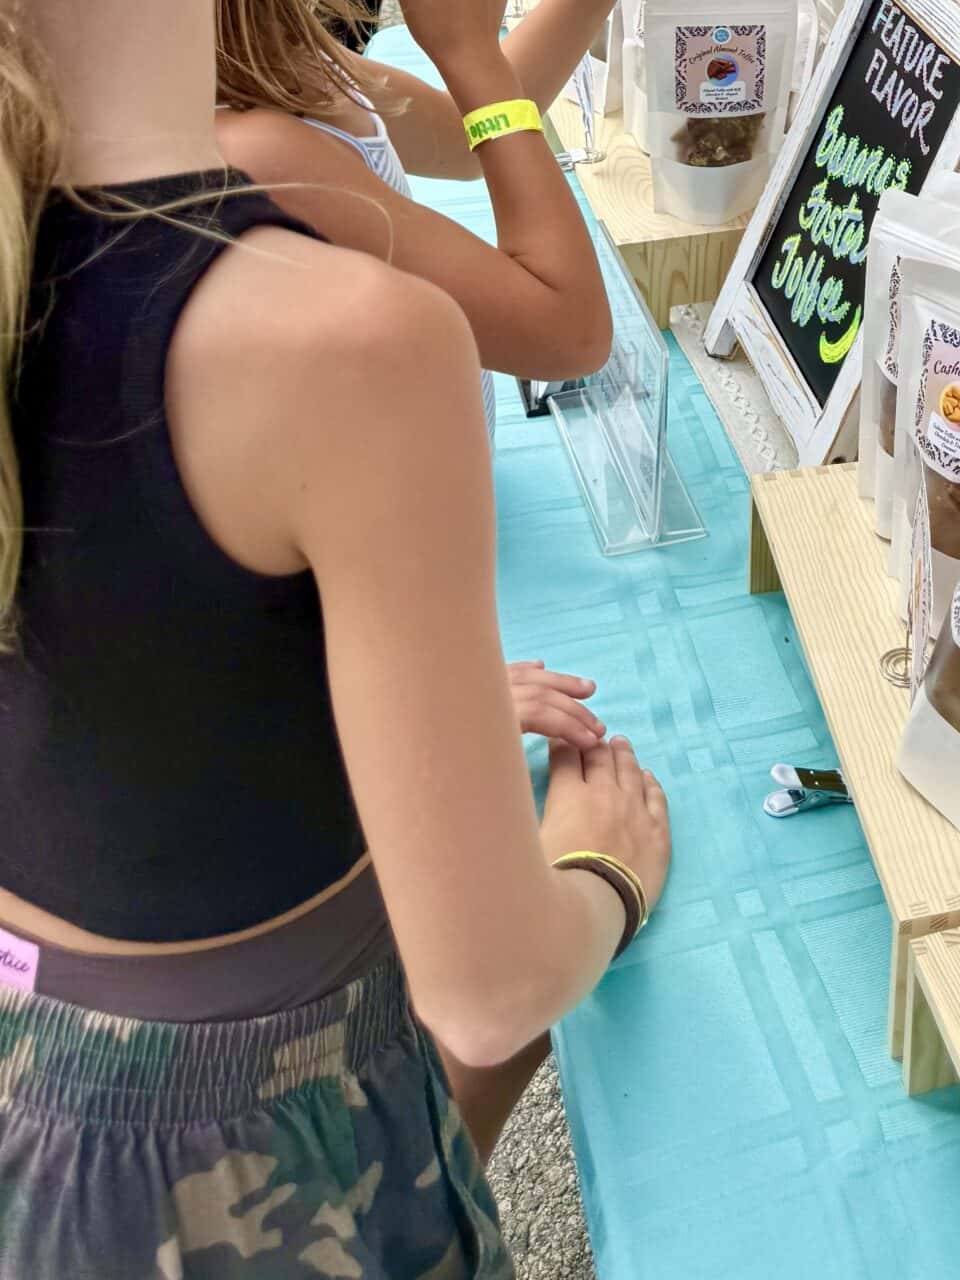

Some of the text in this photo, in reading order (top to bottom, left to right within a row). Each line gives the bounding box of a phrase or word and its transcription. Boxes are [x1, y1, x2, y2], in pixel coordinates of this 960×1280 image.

[469, 113, 511, 139] Little
[864, 48, 934, 156] FLAVOR
[771, 234, 852, 328] Toffee
